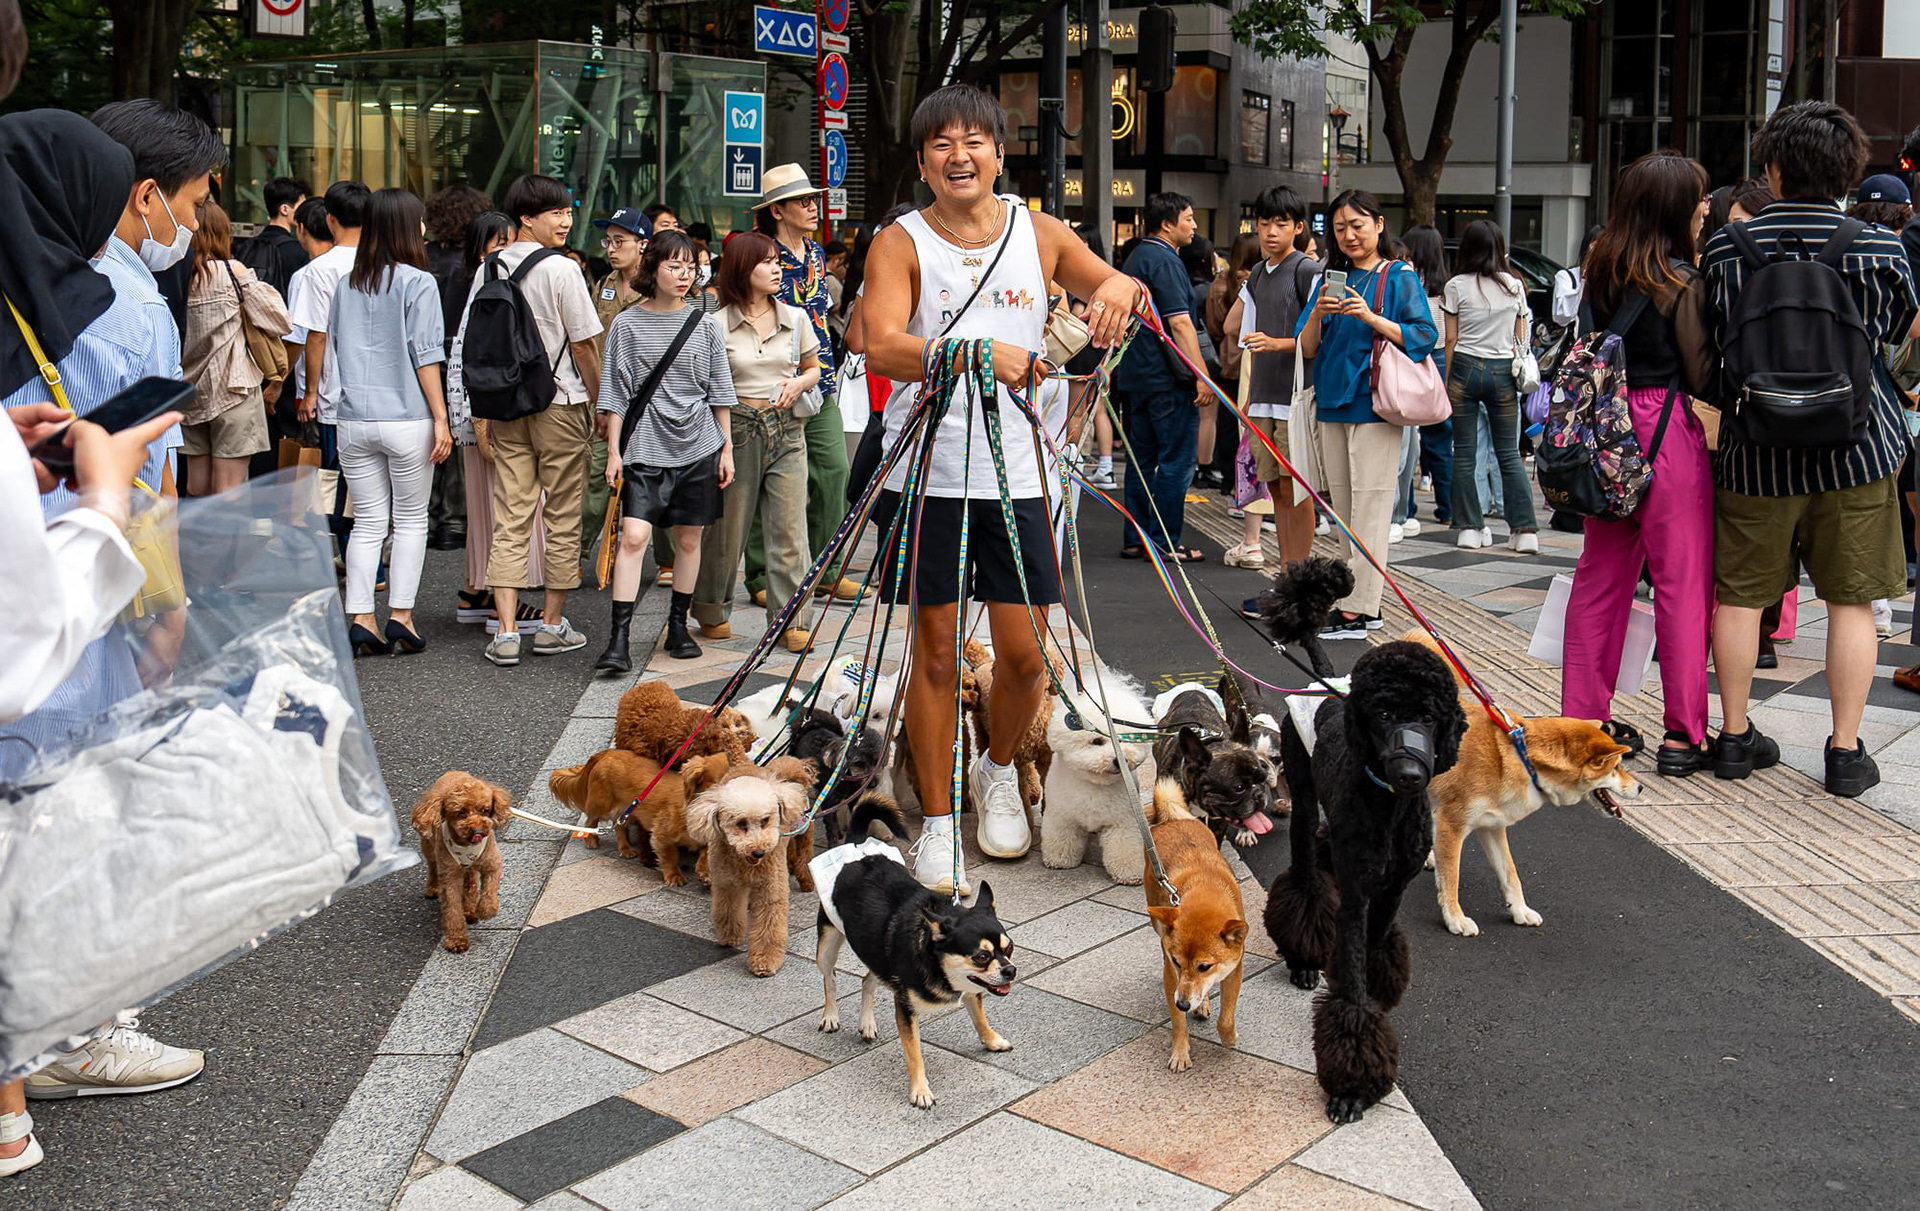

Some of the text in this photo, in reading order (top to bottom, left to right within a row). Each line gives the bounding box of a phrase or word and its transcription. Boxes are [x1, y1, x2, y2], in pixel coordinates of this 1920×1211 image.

[549, 115, 565, 178] Metro
[828, 146, 837, 180] P
[1064, 180, 1134, 196] PARA
